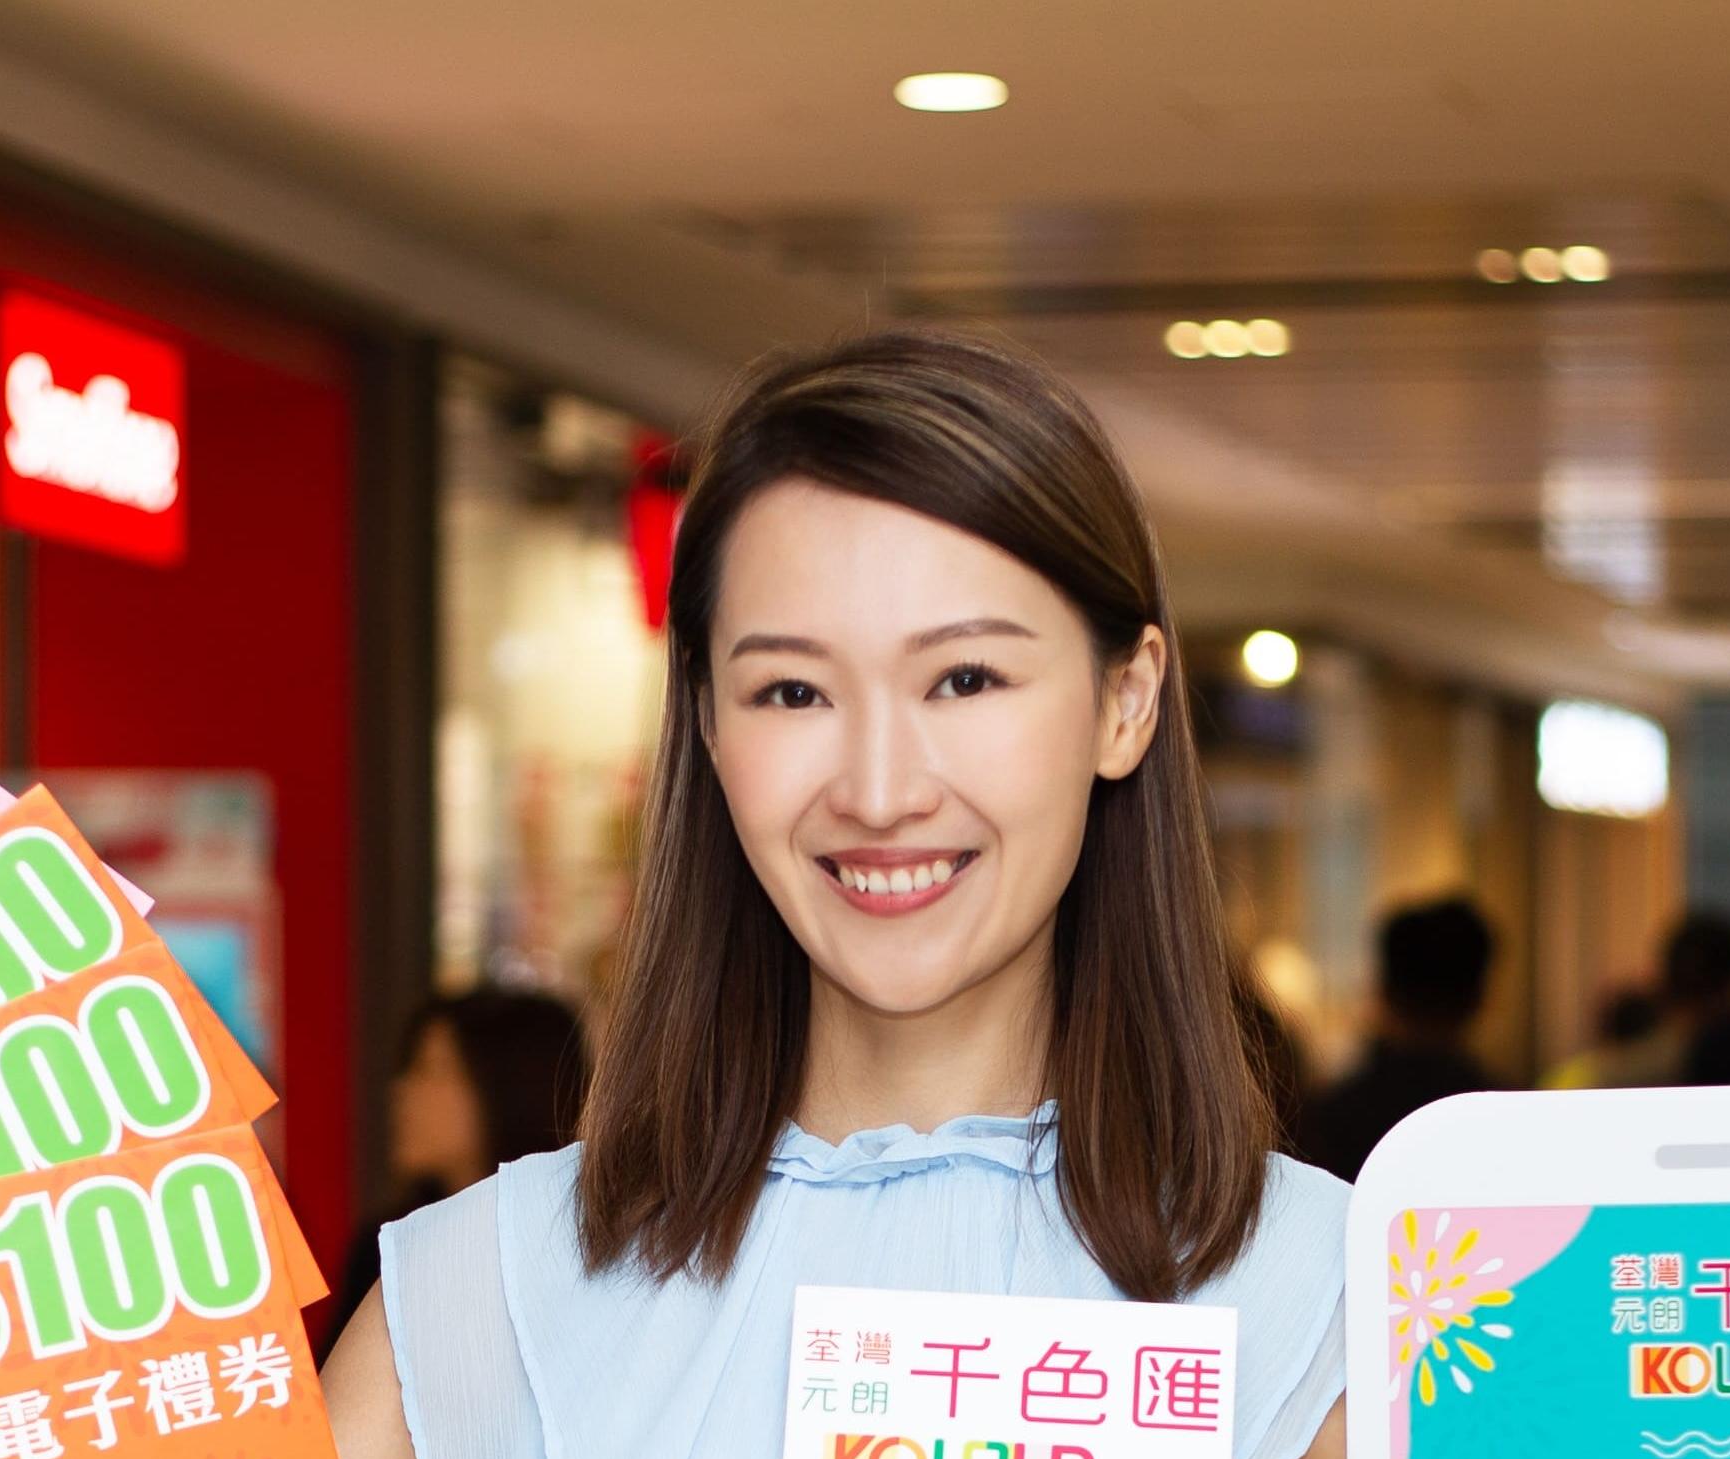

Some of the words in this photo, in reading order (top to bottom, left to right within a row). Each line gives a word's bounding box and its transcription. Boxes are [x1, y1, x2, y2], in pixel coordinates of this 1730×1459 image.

[1611, 1256, 1681, 1290] 荃灣
[1611, 1298, 1681, 1333] 元朗
[805, 1329, 892, 1365] 荃灣
[801, 1377, 888, 1415] 元朗
[910, 1337, 1222, 1432] 千色匯
